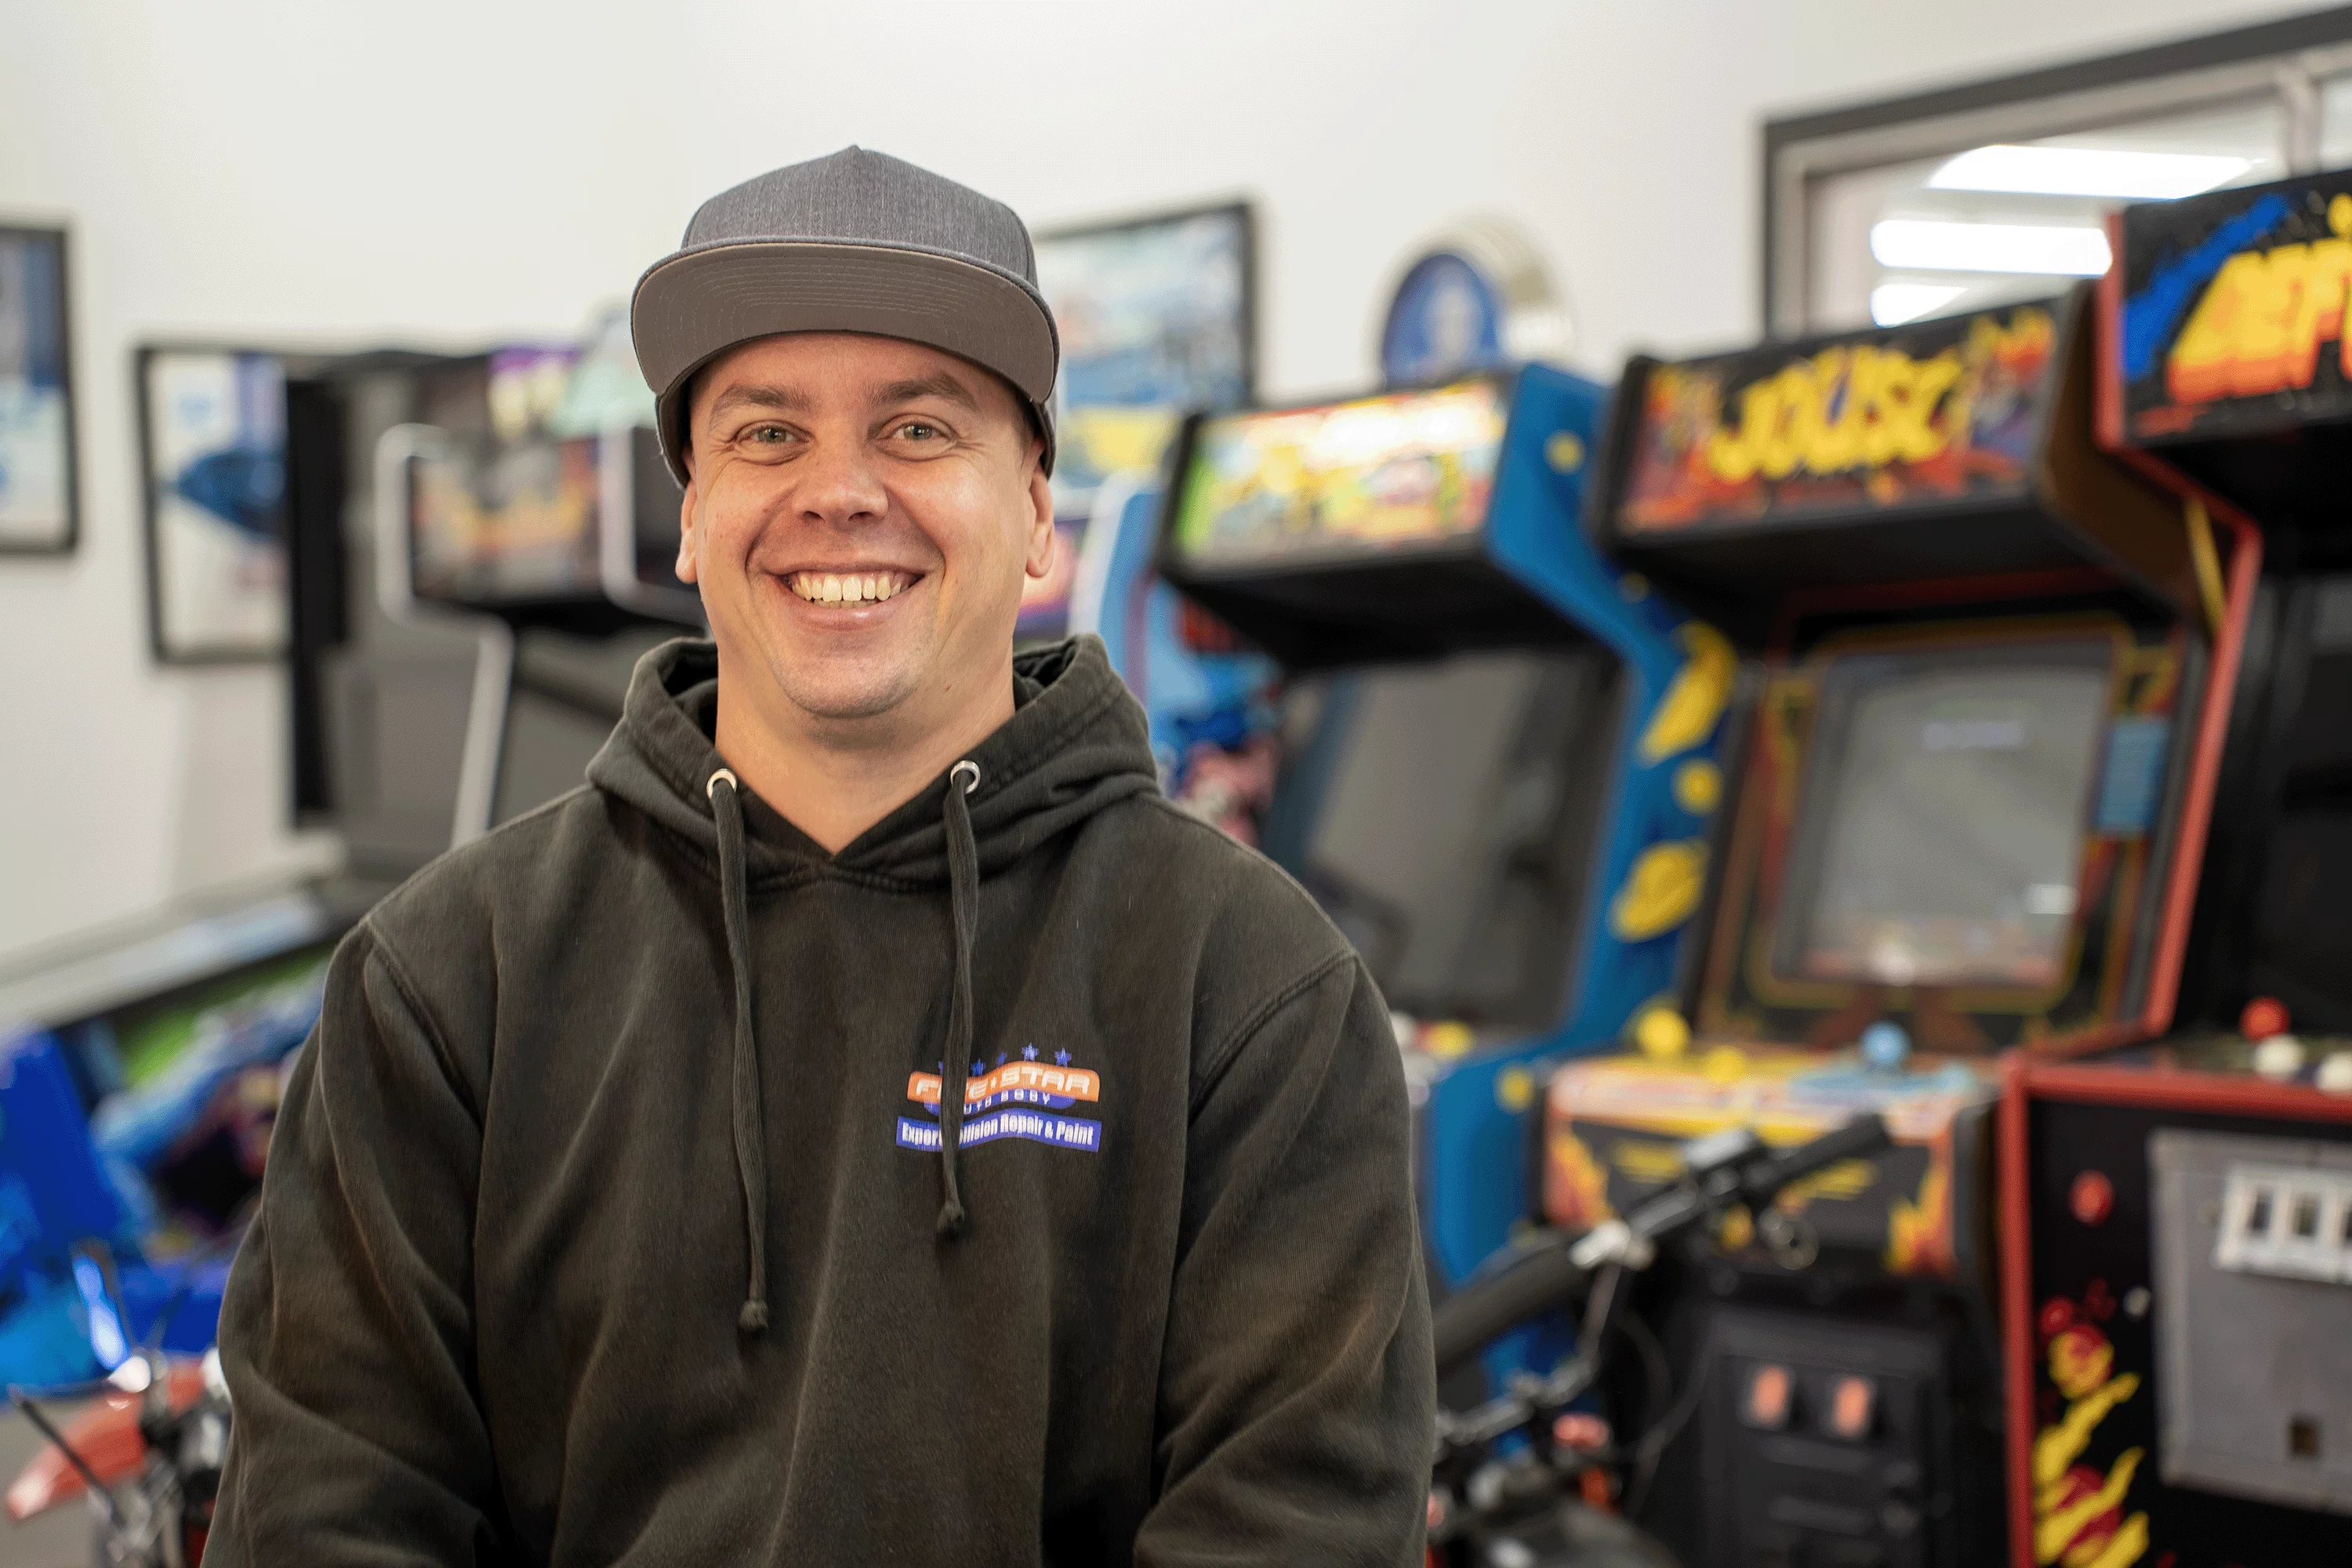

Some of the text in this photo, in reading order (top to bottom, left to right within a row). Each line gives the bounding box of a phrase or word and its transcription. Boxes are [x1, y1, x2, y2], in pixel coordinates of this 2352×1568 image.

[916, 1066, 1090, 1100] FIE STAR
[959, 1118, 998, 1144] llision
[1000, 1113, 1043, 1136] Repair
[1044, 1120, 1054, 1139] &
[1056, 1120, 1094, 1145] Paint
